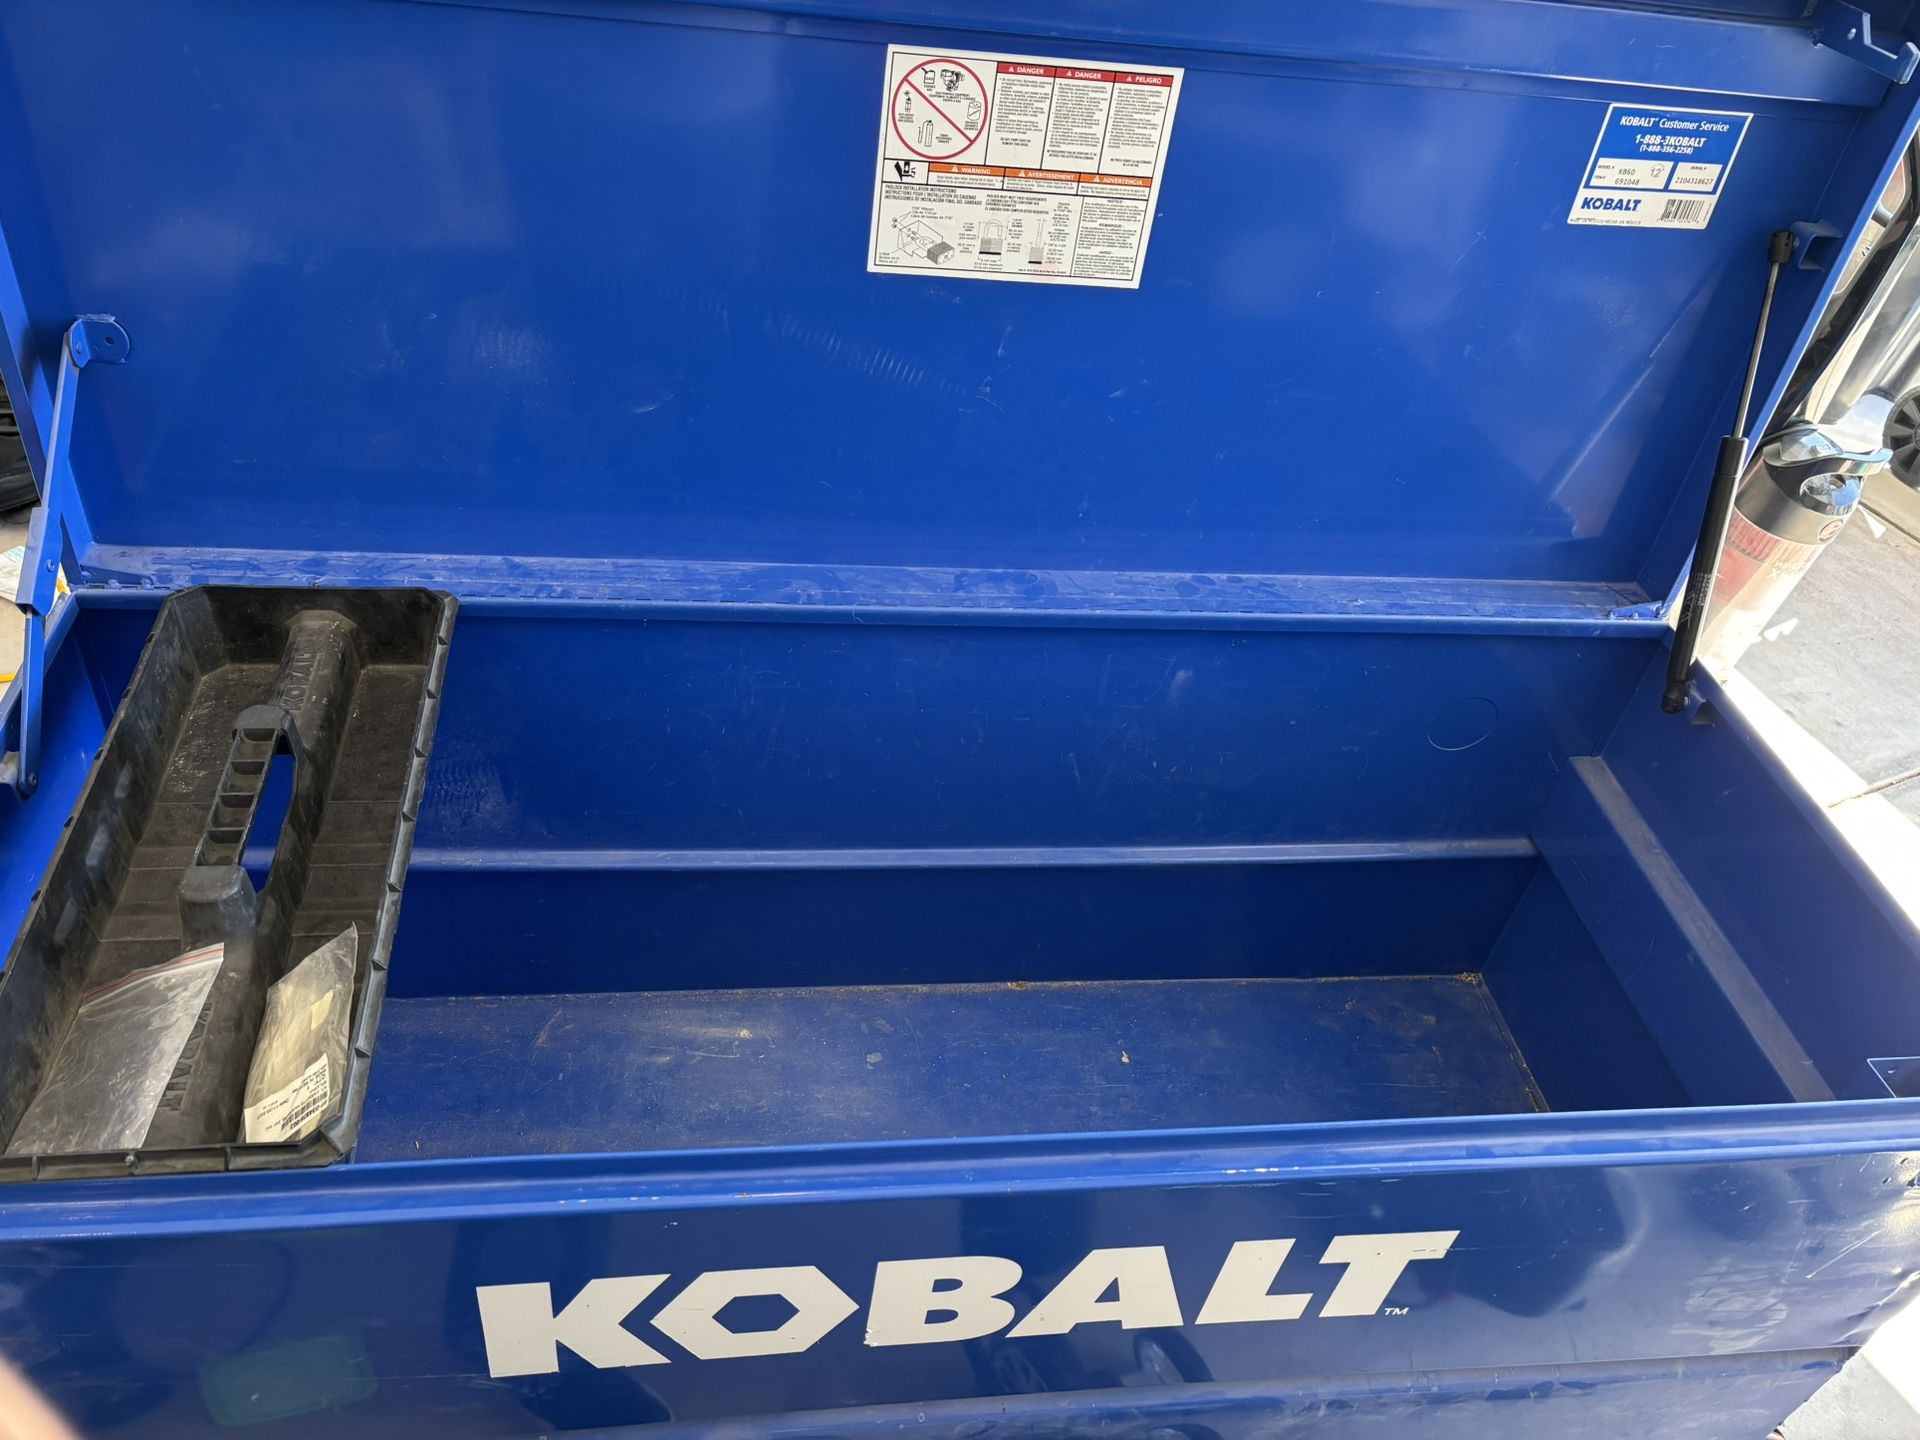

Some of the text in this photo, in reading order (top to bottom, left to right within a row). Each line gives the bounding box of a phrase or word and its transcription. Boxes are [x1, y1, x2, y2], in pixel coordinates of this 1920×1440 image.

[1016, 66, 1044, 74] DANGER
[1074, 71, 1101, 79] DANGER
[1659, 118, 1699, 131] Customer
[1699, 120, 1730, 132] Service
[1635, 134, 1707, 148] 1-888-3KOBALT
[1027, 172, 1073, 180] AVERTISSEMENT
[1103, 177, 1142, 185] ADVERTENCIA
[1614, 178, 1640, 186] 691048
[1580, 196, 1641, 212] KOBALT
[476, 1230, 1460, 1378] KOBALT
